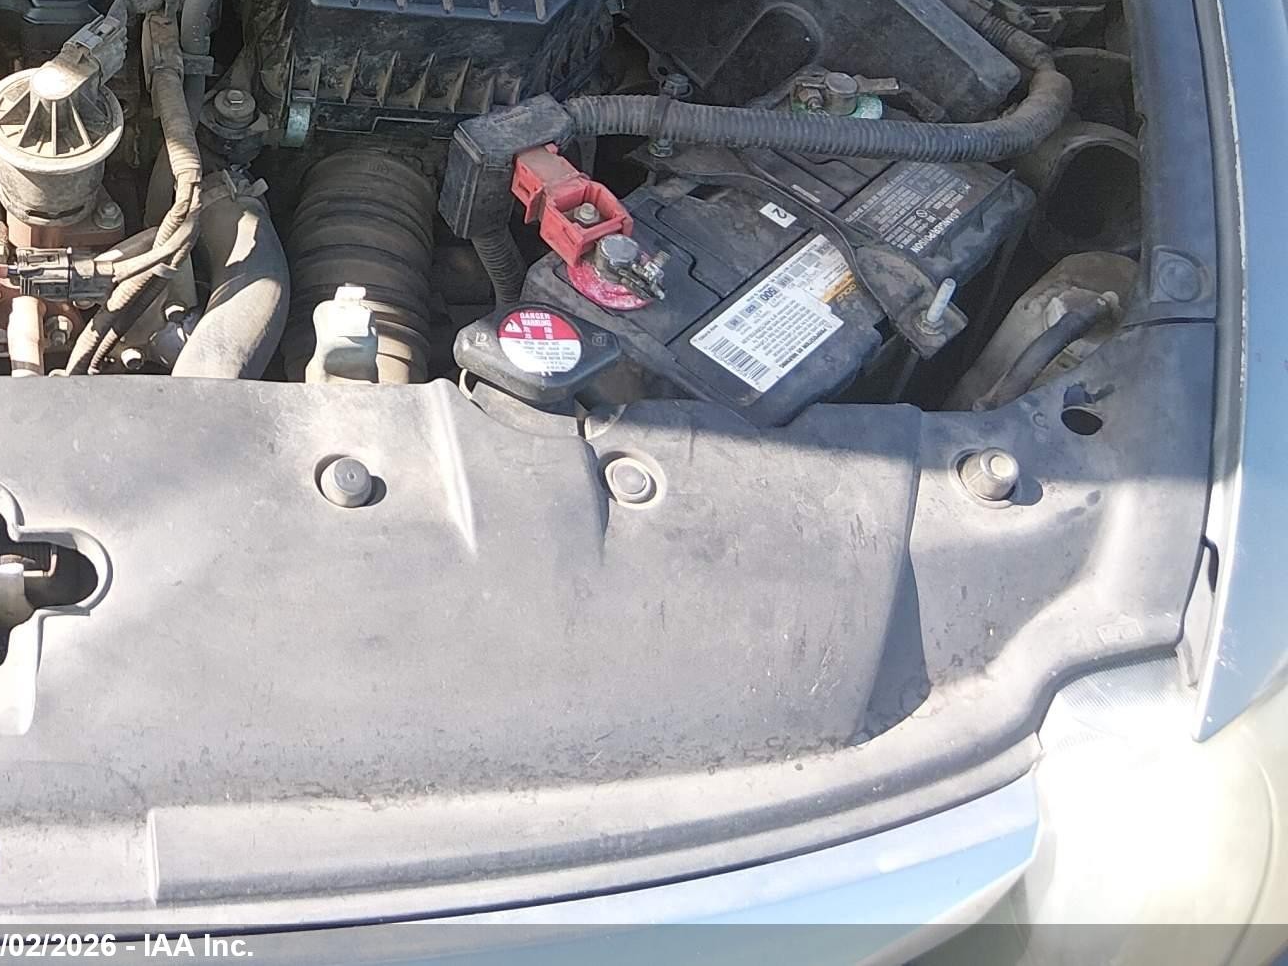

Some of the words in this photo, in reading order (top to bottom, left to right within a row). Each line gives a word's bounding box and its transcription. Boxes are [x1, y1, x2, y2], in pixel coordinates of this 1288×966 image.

[771, 207, 788, 220] 2
[758, 285, 778, 303] 500
[519, 312, 551, 320] DANGER
[520, 319, 553, 327] WARNING
